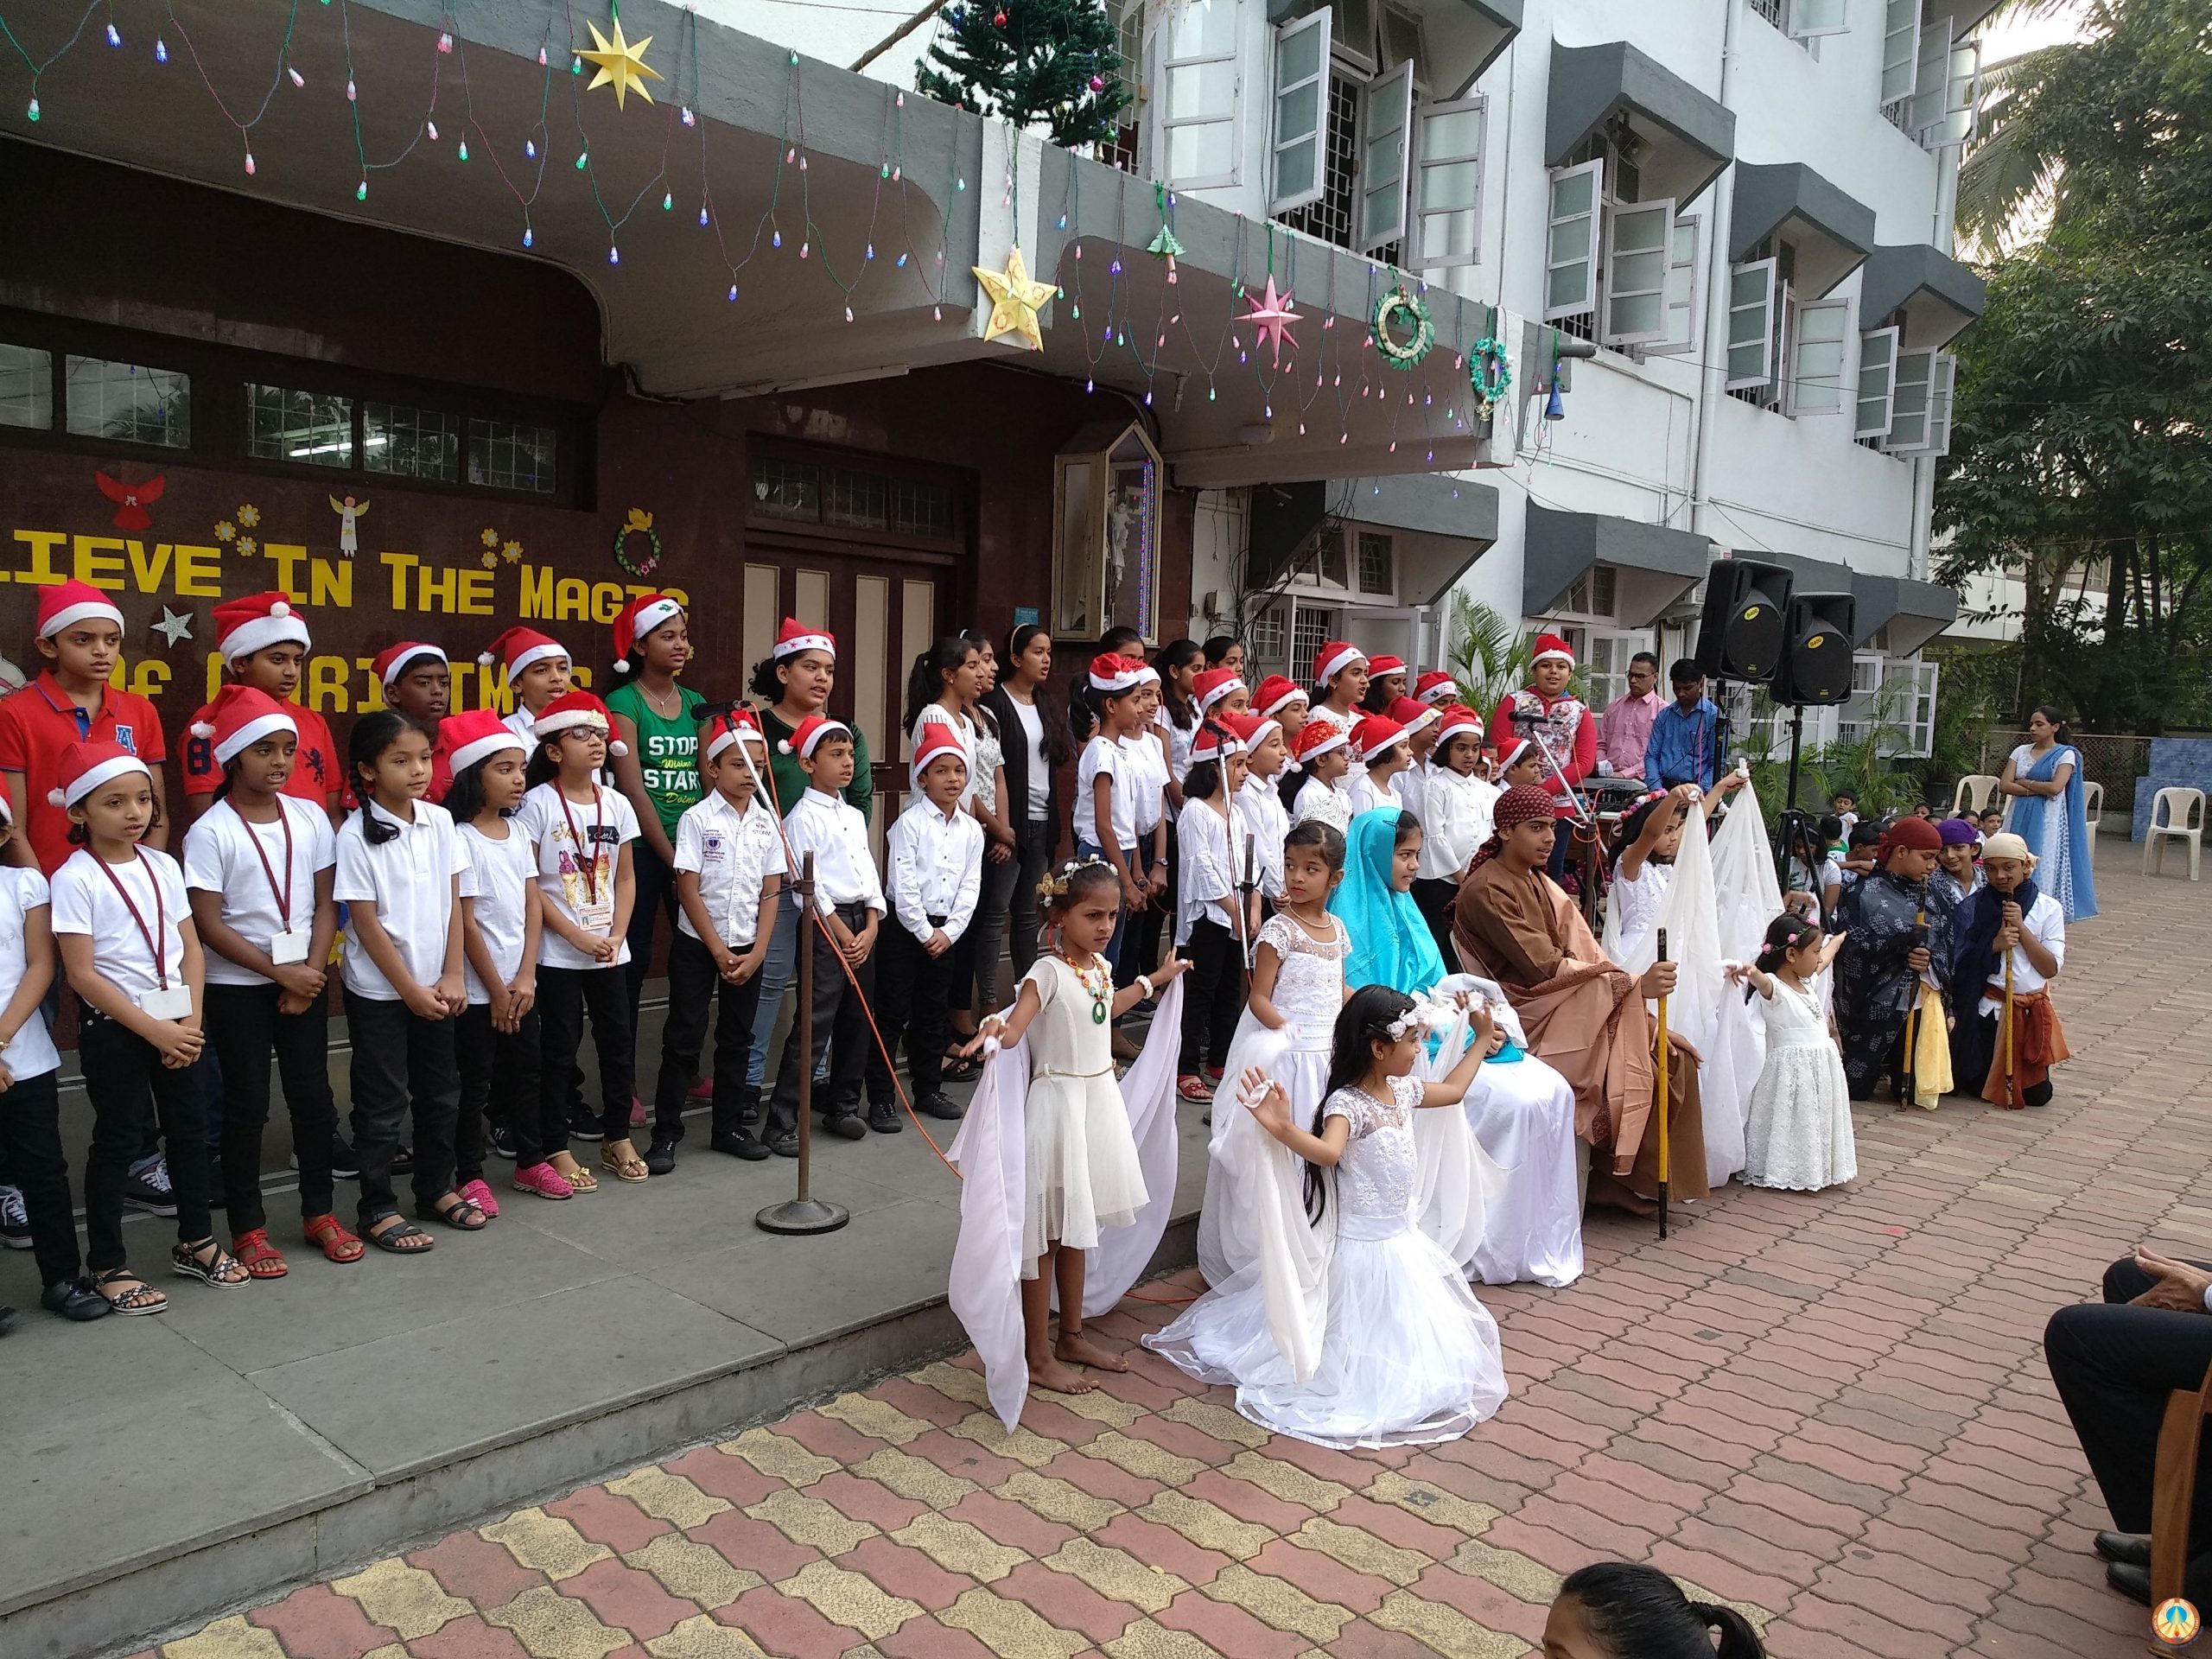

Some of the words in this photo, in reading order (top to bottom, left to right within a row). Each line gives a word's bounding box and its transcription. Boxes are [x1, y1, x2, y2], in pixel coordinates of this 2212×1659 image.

[264, 543, 353, 607] IN
[379, 552, 495, 615] THE
[519, 564, 690, 625] MAGC
[648, 735, 699, 756] STOP
